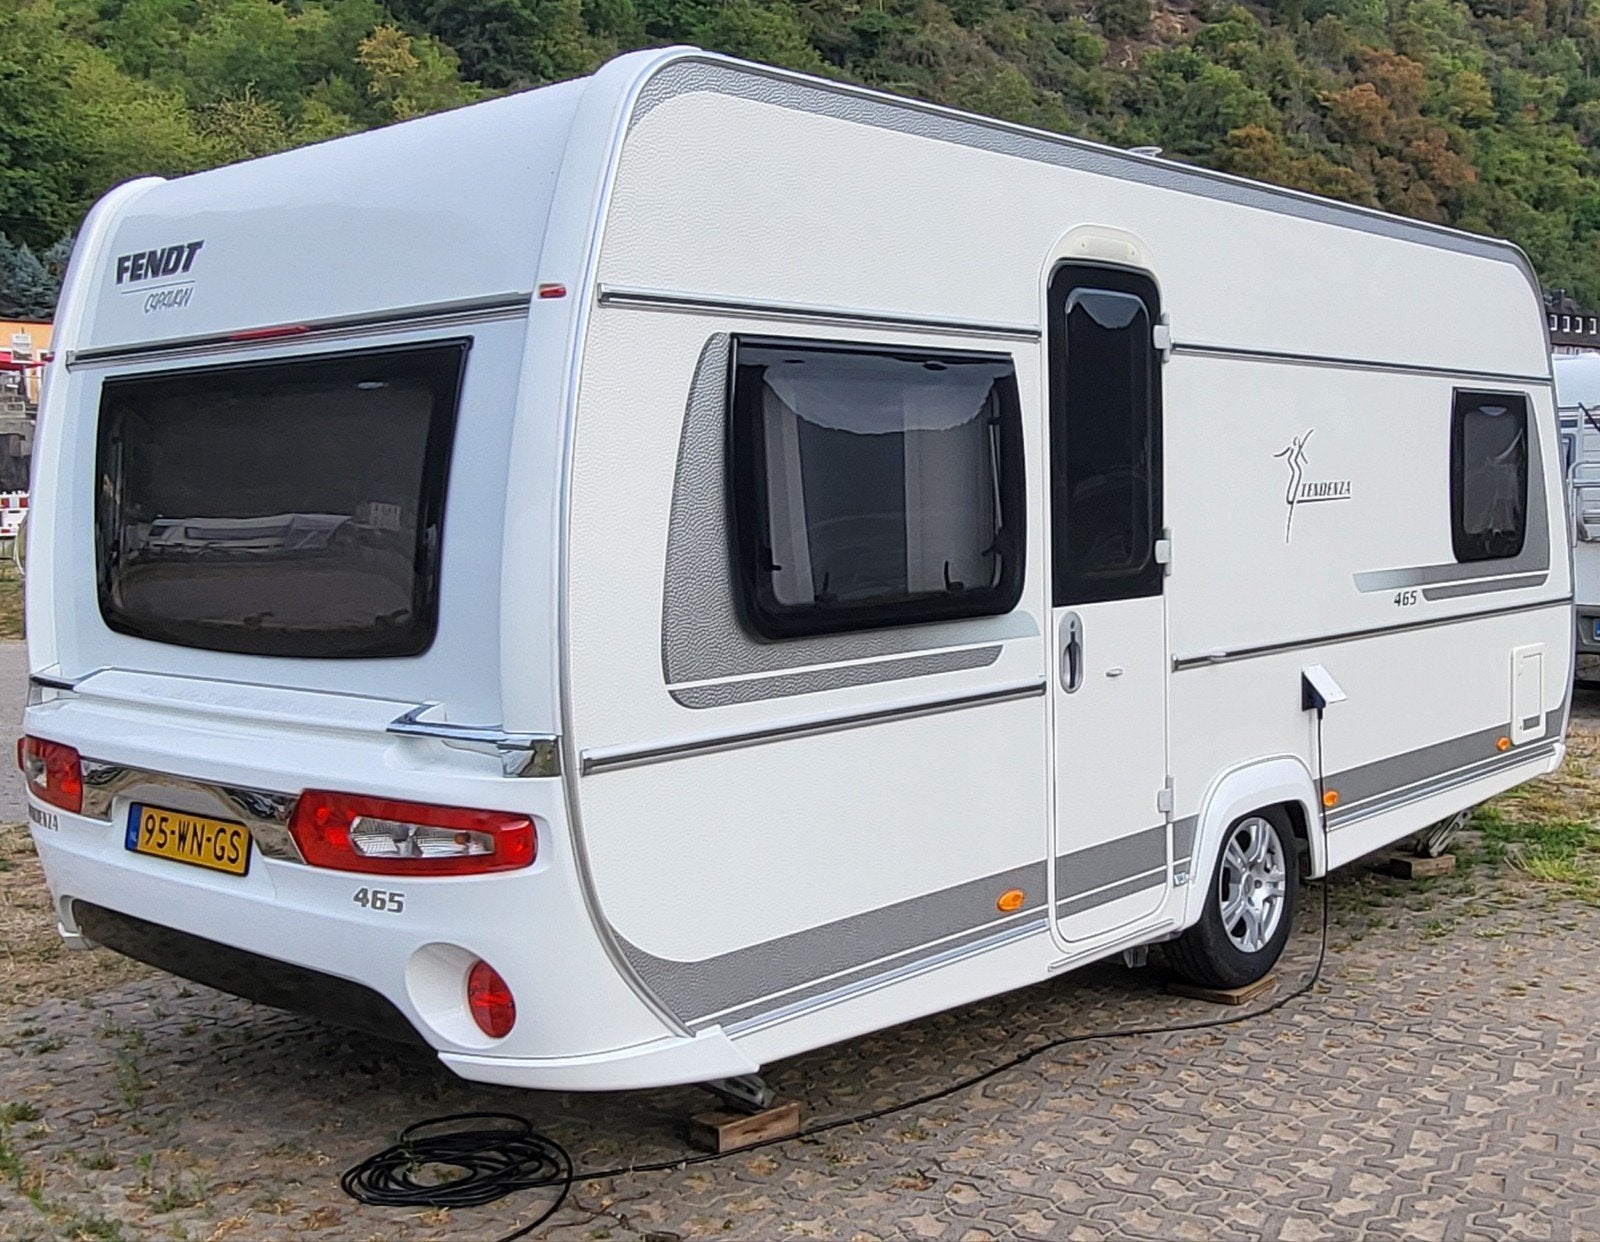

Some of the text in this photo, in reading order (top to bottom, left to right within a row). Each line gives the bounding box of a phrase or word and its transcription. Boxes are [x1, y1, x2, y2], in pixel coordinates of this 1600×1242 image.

[116, 240, 205, 285] FENDT
[1301, 480, 1352, 498] TENDENZA
[1394, 590, 1418, 607] 465
[144, 813, 242, 865] 95-WN-GS
[353, 887, 405, 914] 465
